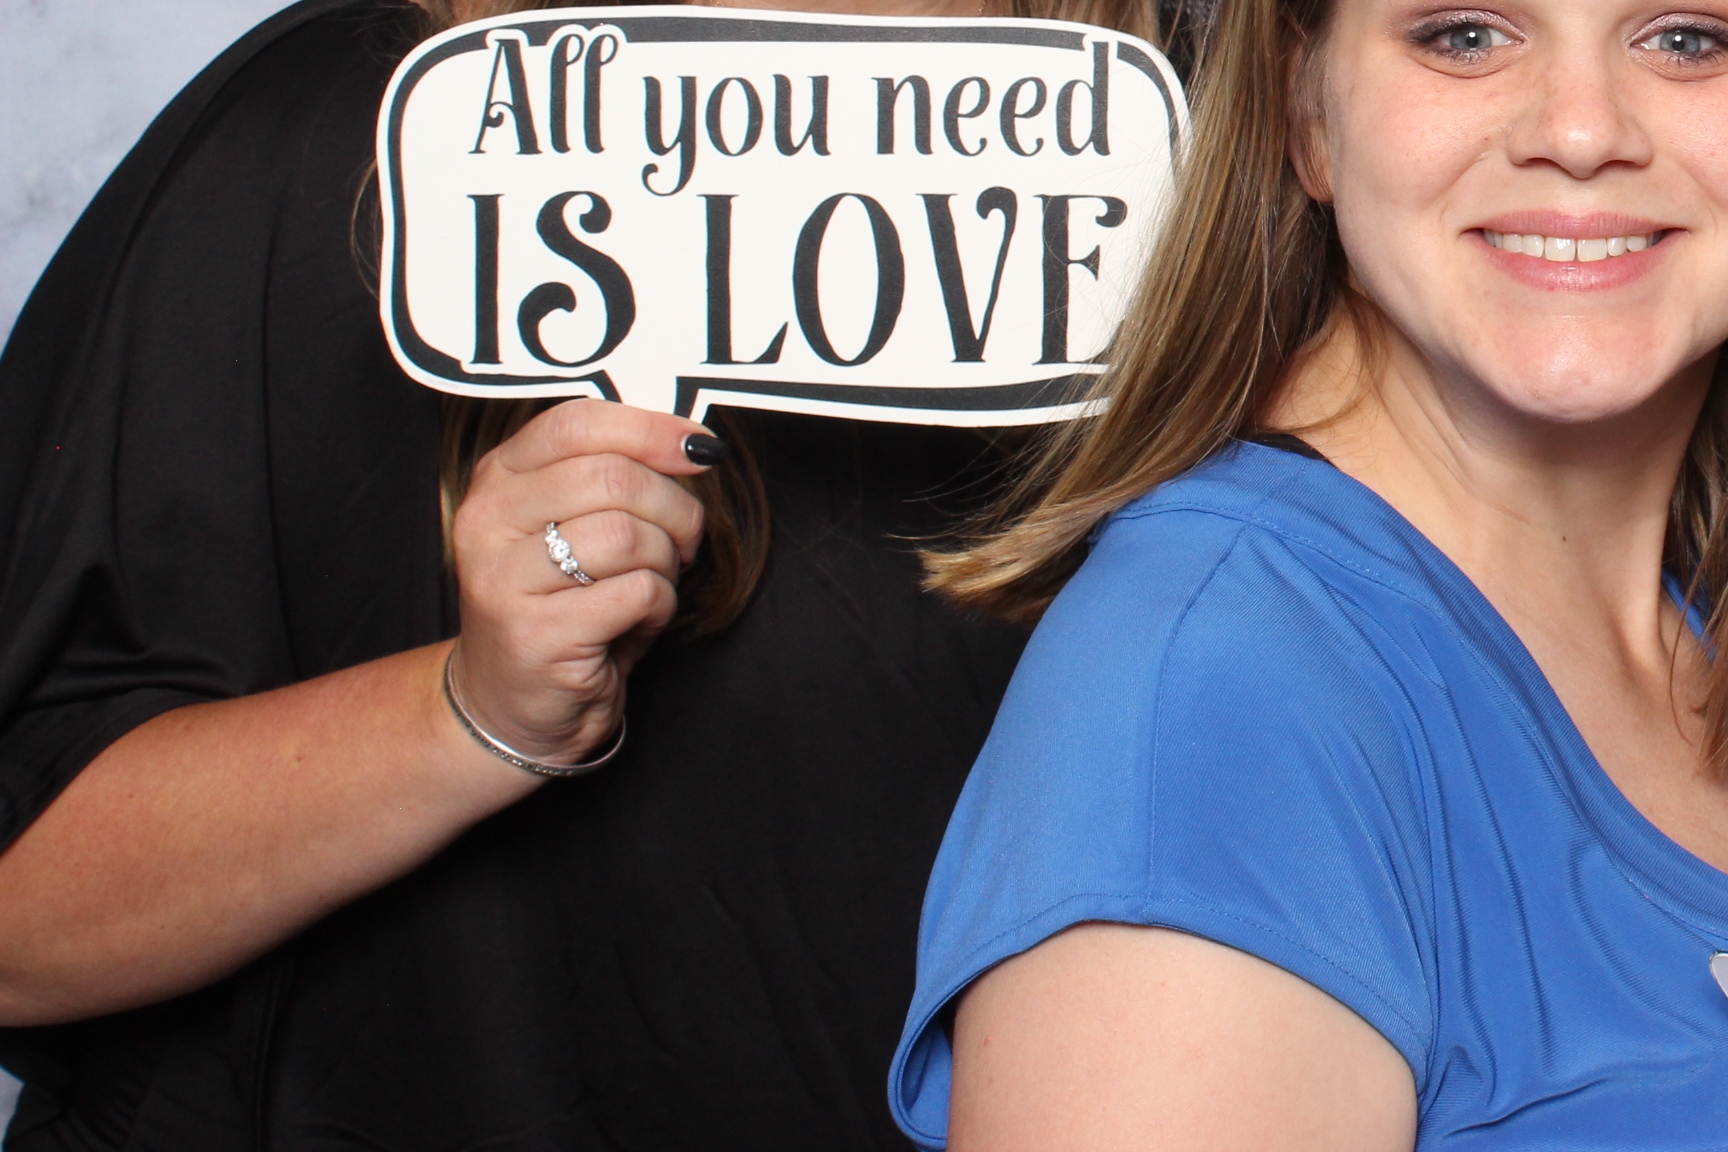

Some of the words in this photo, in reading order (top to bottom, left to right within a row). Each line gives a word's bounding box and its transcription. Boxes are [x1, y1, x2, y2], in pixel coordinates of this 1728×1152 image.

[468, 33, 618, 155] All
[641, 74, 831, 196] you
[871, 42, 1110, 156] need
[467, 191, 636, 367] IS
[697, 186, 1127, 367] LOVE
